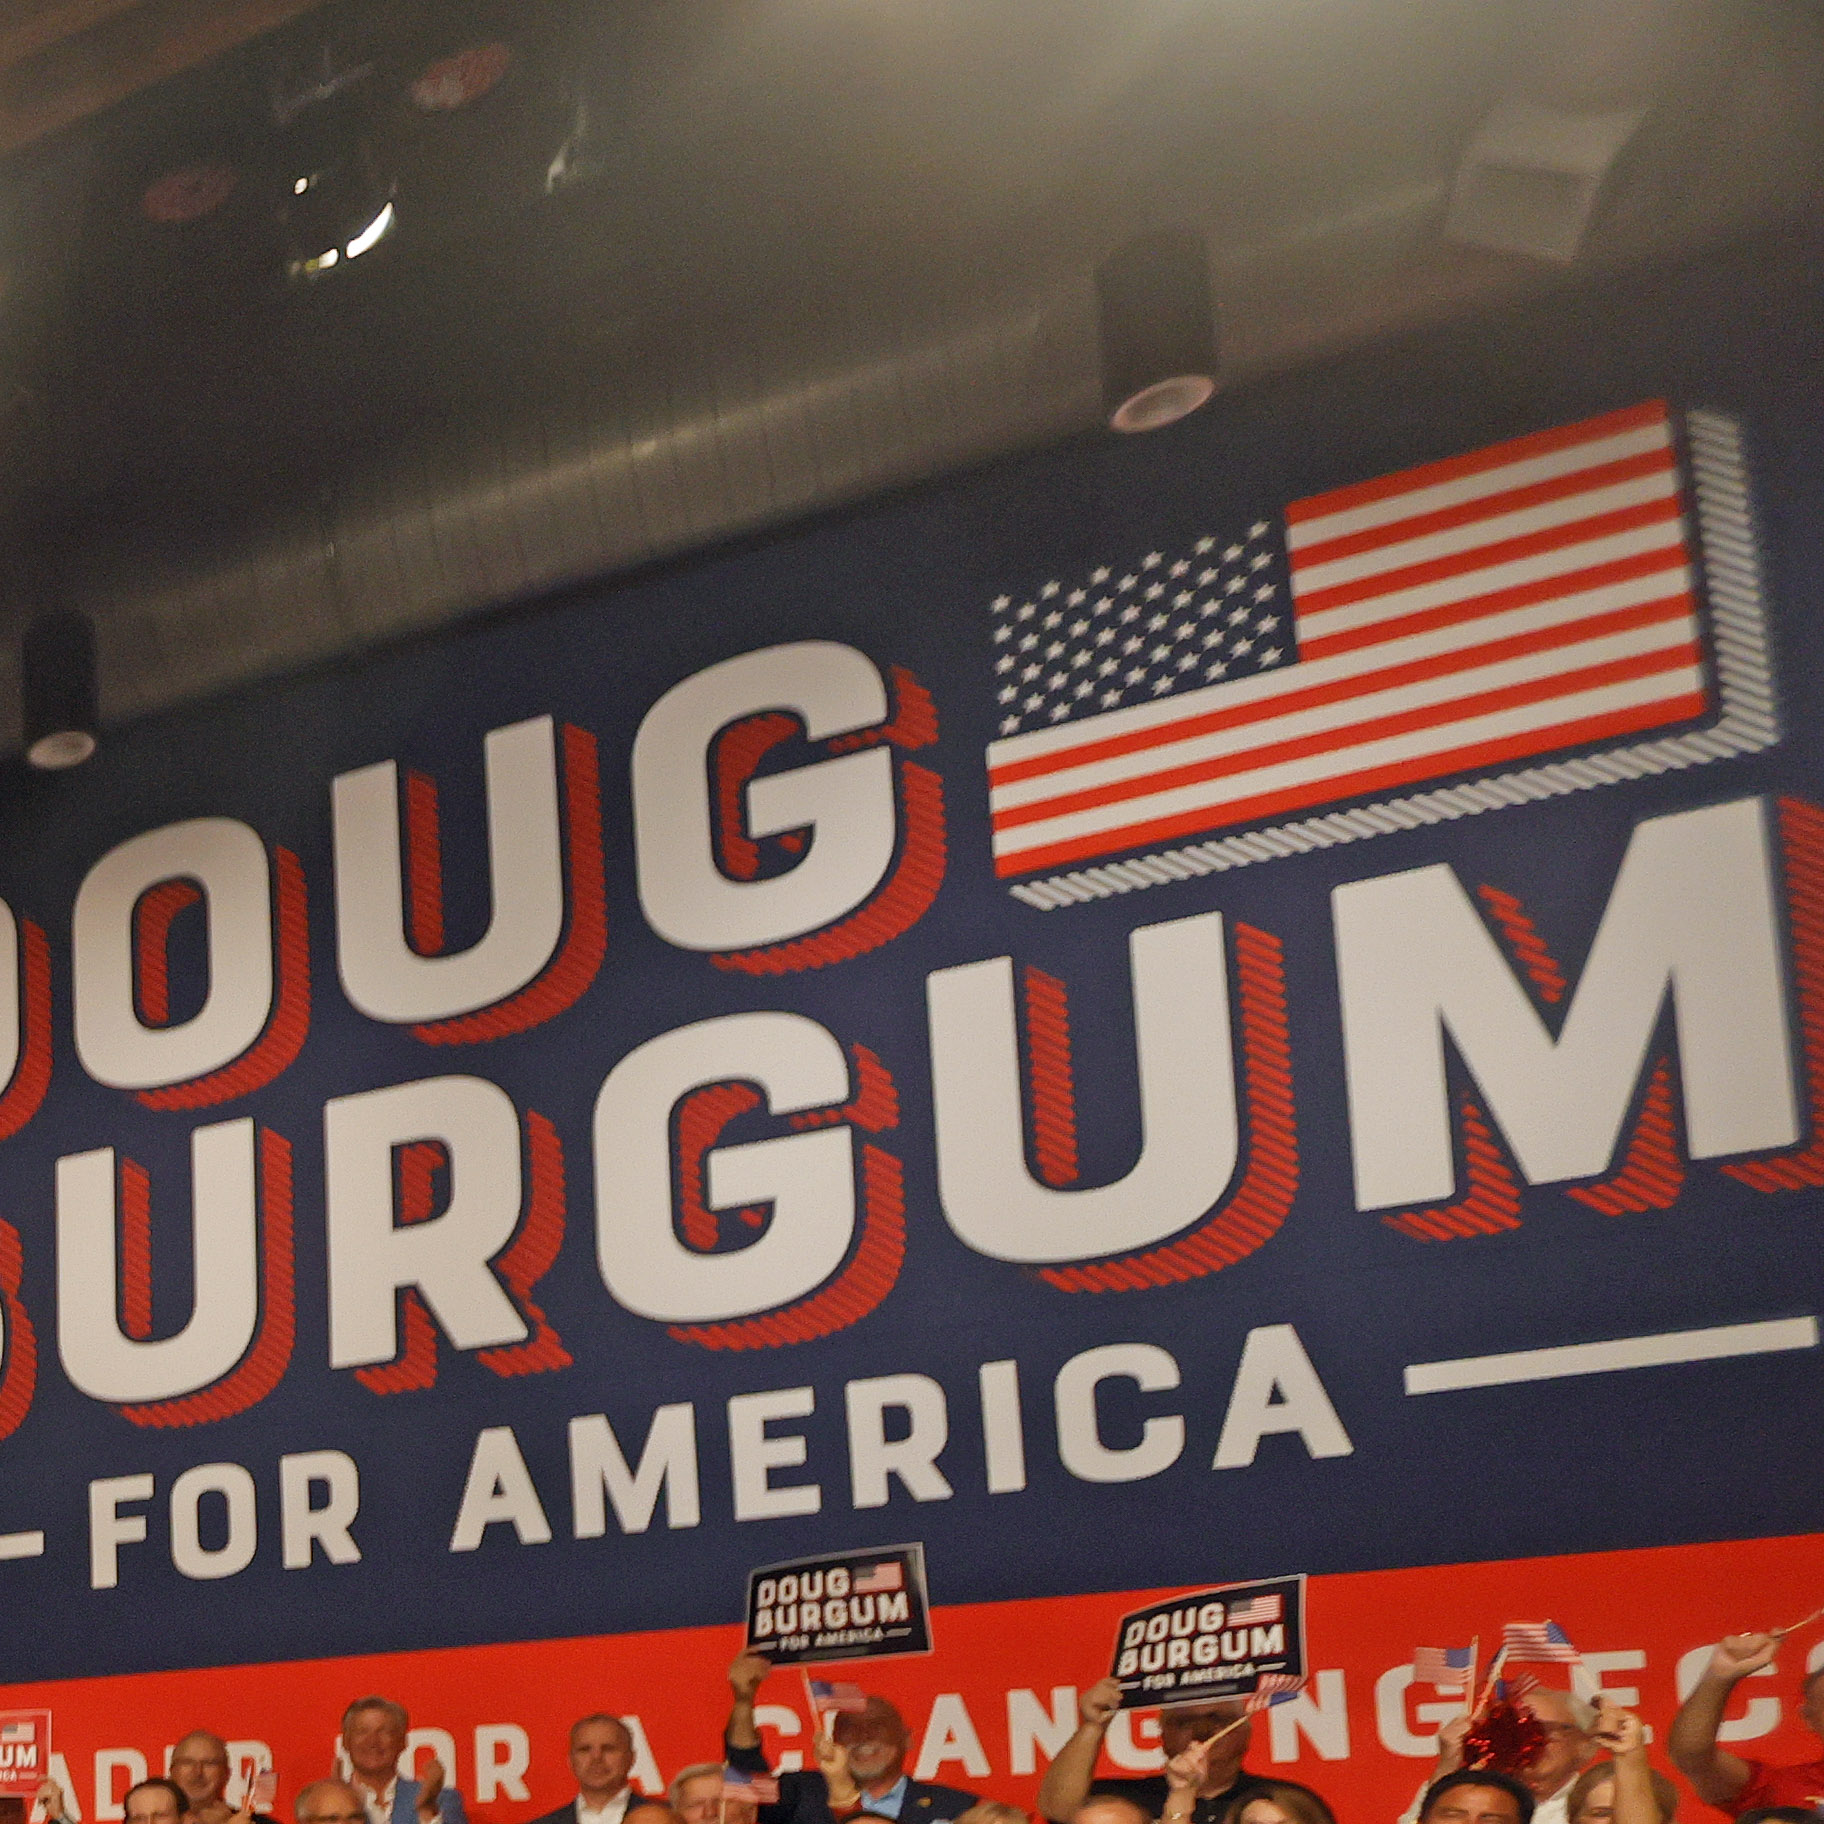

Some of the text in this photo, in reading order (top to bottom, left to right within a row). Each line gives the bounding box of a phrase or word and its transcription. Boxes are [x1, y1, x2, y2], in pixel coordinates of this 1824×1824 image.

[89, 1322, 1354, 1590] FOR AMERICA
[757, 1566, 850, 1609] DOUG
[754, 1590, 910, 1637] BURGUM
[1123, 1601, 1226, 1649] DOUG
[1116, 1623, 1285, 1677] BURGUM
